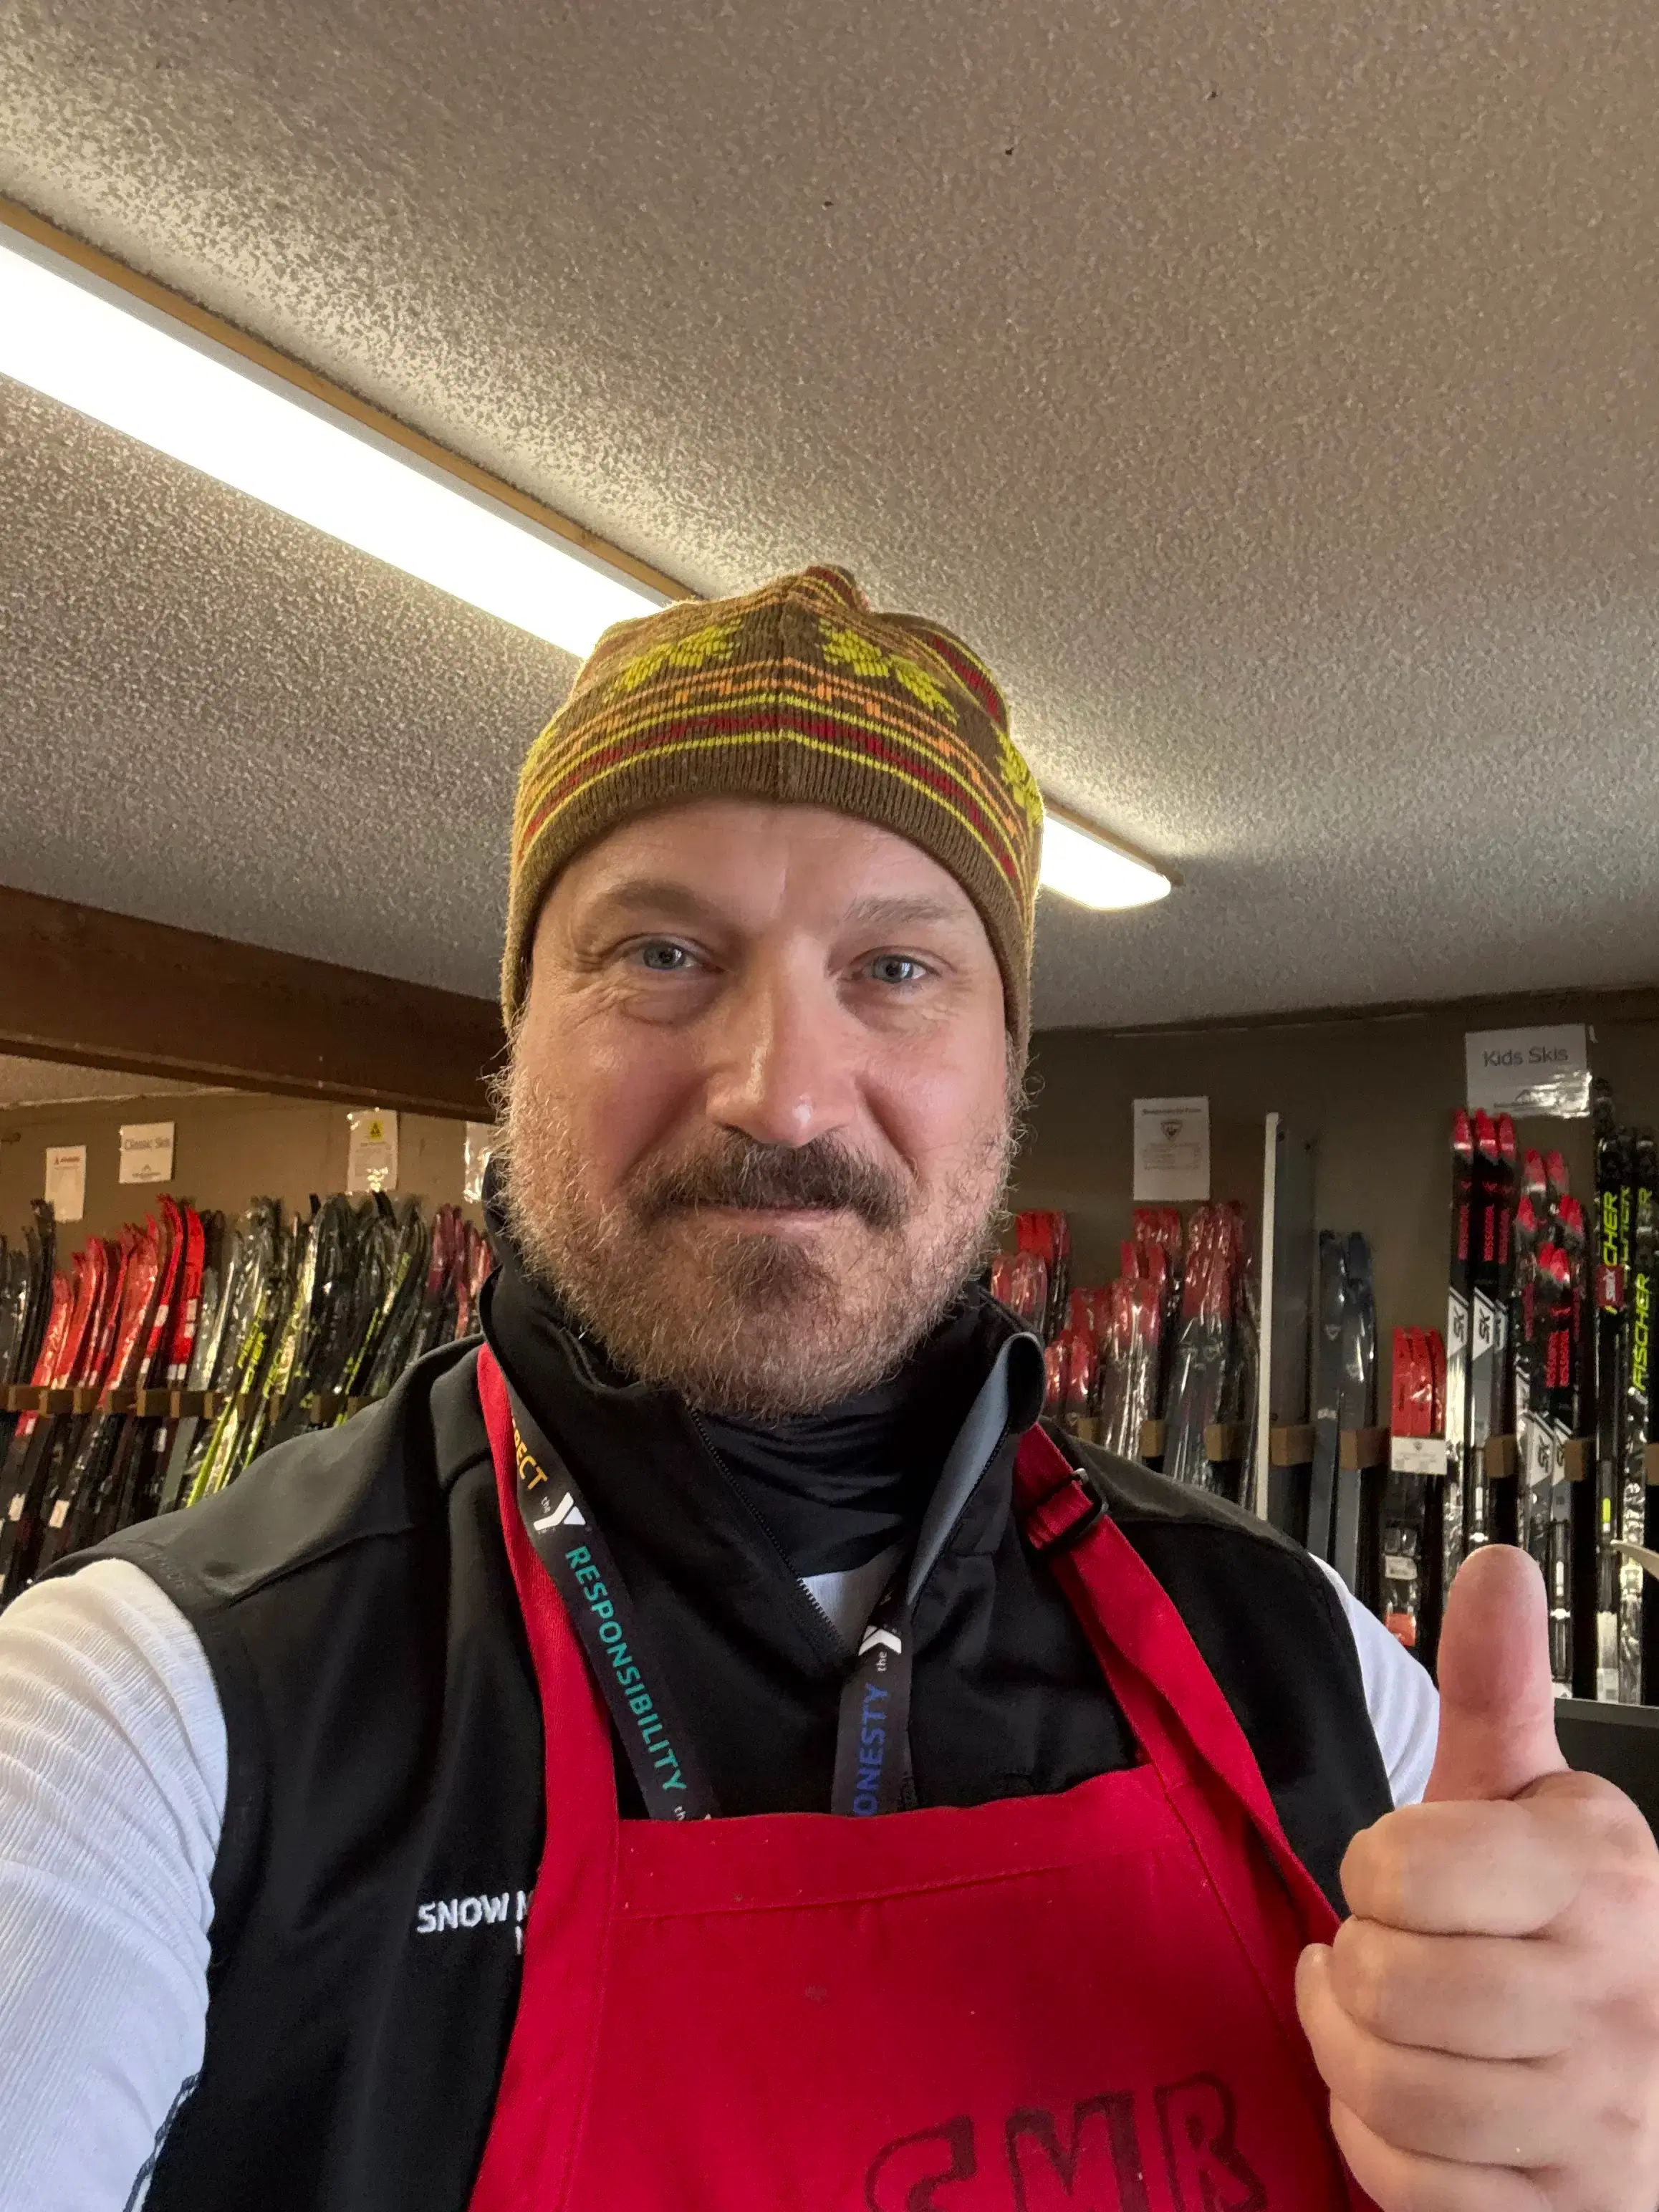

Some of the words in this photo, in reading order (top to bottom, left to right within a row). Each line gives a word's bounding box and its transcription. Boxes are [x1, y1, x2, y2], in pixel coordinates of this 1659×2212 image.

[1483, 1049, 1524, 1067] Kids
[1529, 1045, 1569, 1064] Skis
[1603, 1191, 1617, 1267] CHER
[1632, 1273, 1650, 1392] FISCHER
[565, 1545, 687, 1790] RESPONSIBILITY
[875, 1650, 888, 1672] the
[853, 1683, 889, 1817] ONESTY
[674, 1806, 686, 1821] th
[416, 1892, 510, 1933] SNOW
